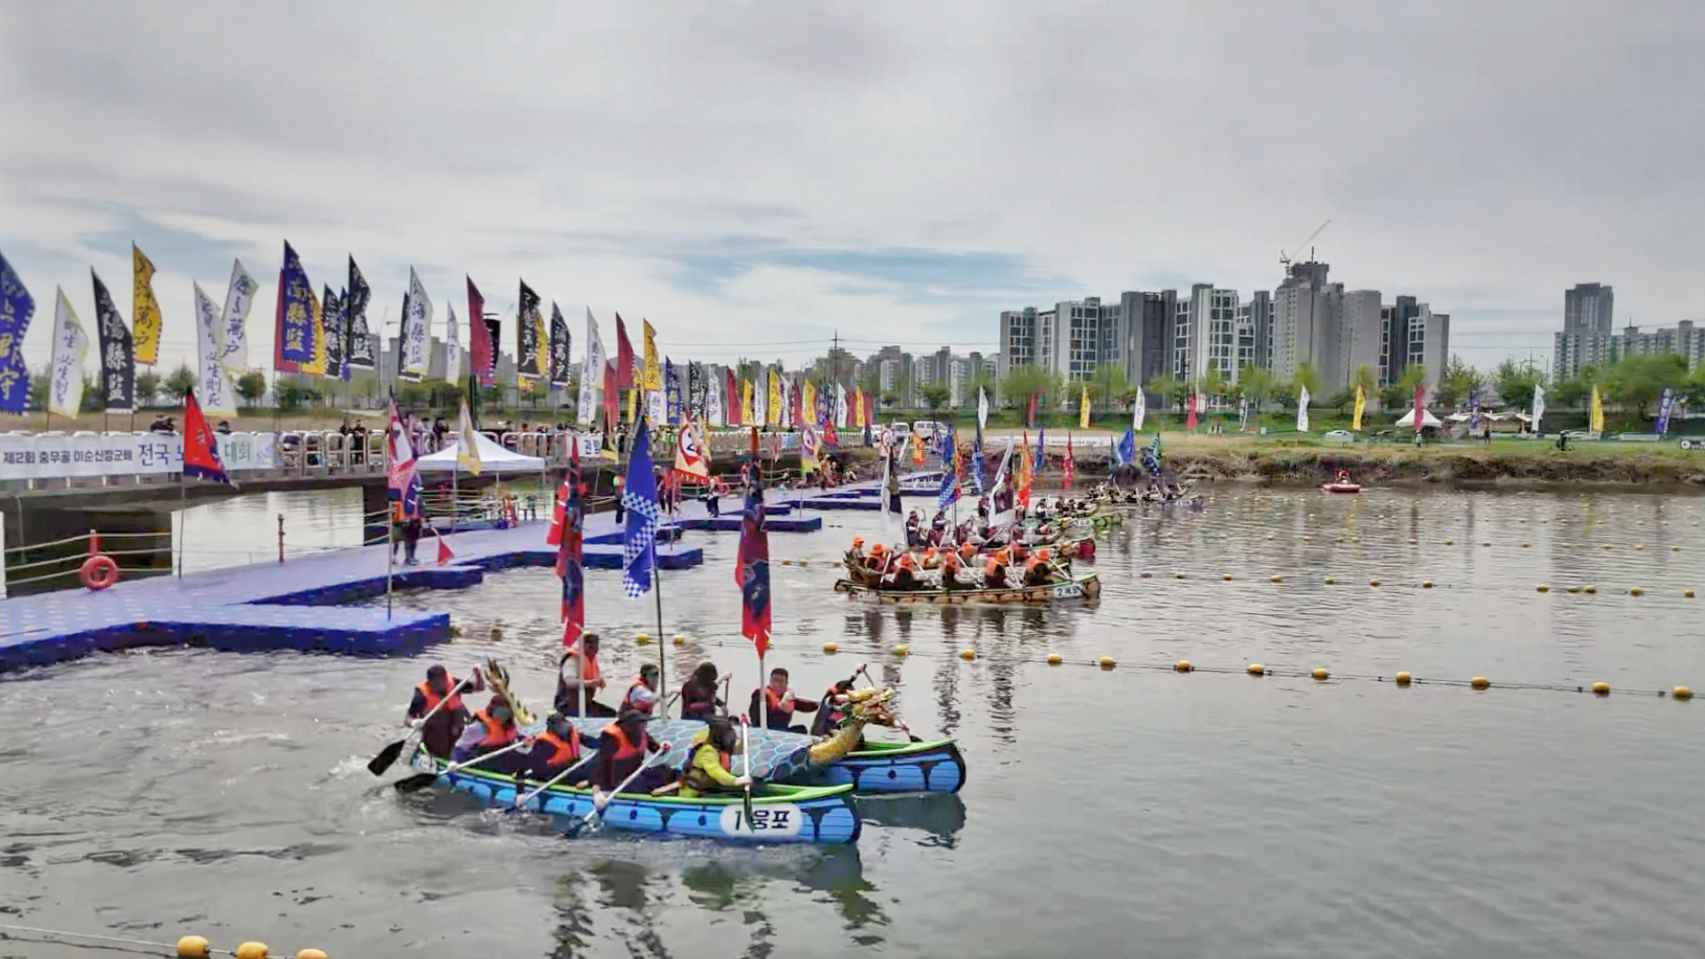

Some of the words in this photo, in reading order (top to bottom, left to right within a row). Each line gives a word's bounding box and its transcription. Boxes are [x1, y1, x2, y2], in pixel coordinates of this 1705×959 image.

[4, 450, 36, 464] 제2회
[138, 442, 171, 466] 전국
[735, 810, 742, 831] 1
